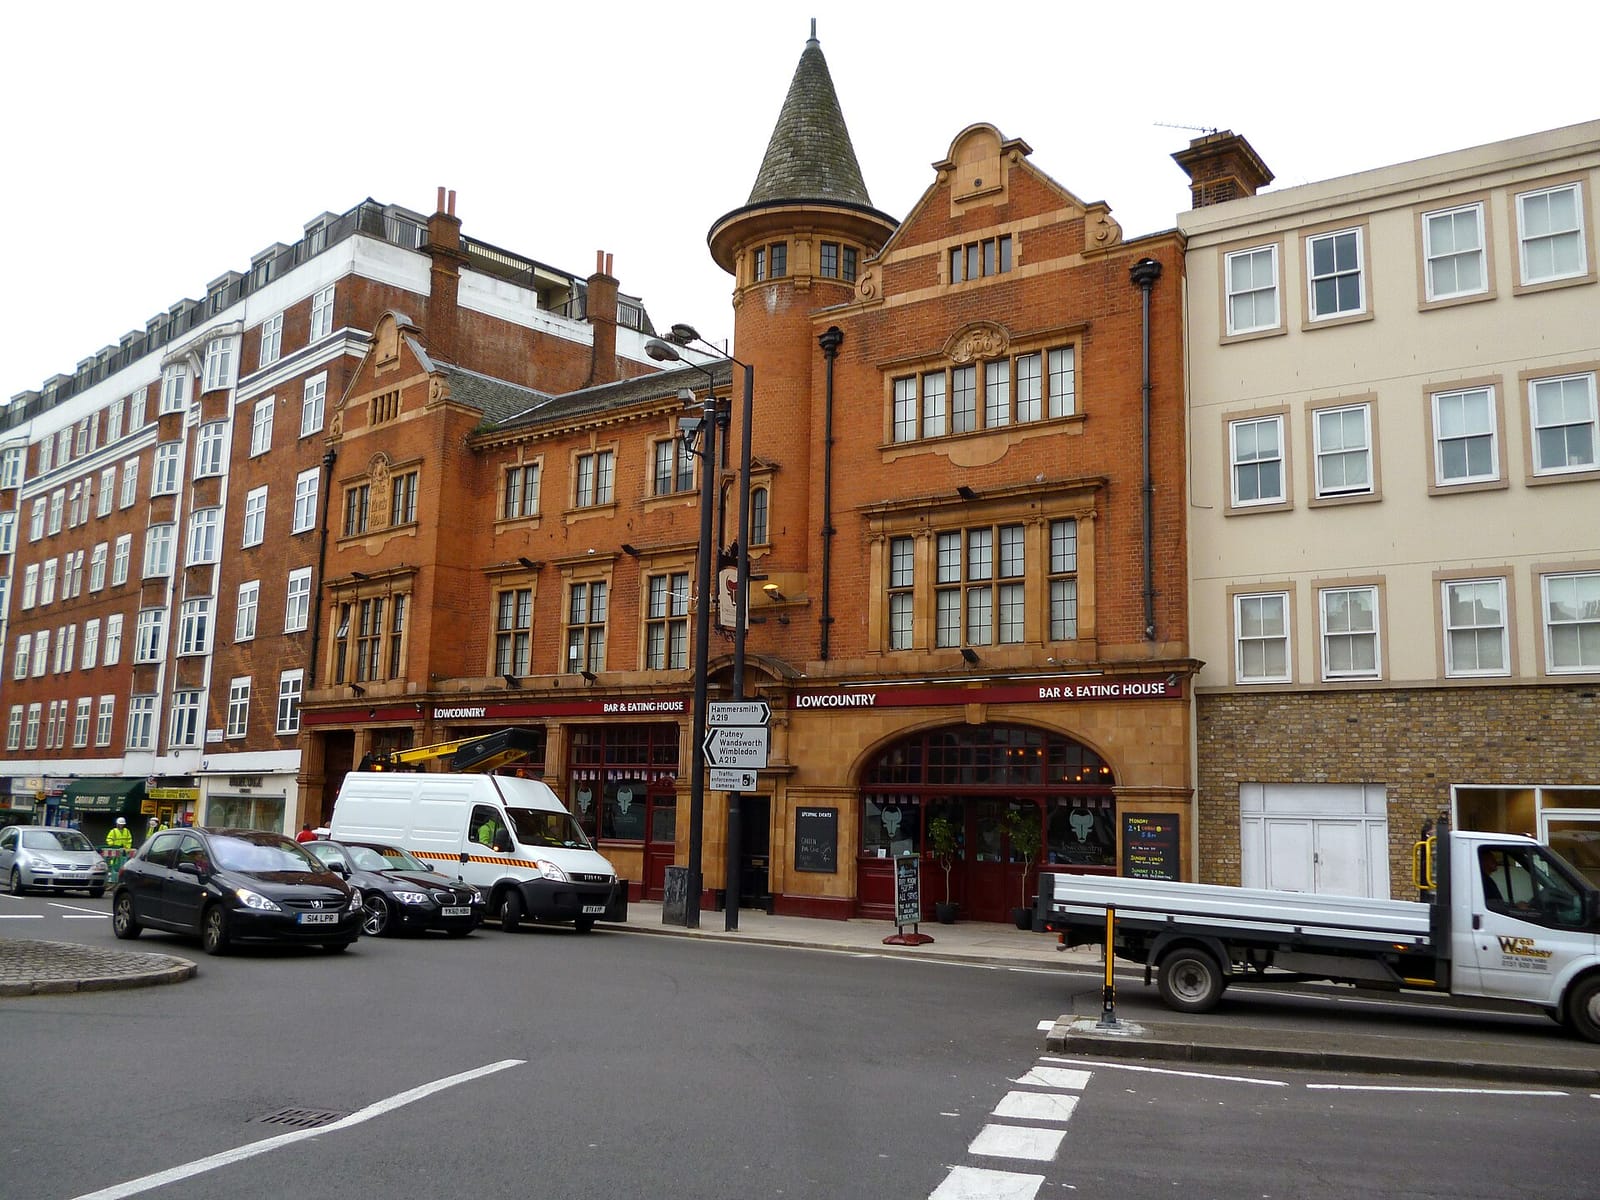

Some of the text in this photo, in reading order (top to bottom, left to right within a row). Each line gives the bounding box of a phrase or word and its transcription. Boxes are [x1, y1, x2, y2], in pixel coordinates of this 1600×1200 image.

[1039, 682, 1165, 698] BAR & EATING HOUSE
[796, 694, 876, 707] LOWCOUNTRY
[603, 701, 684, 712] BAR & EATING HOUSE
[711, 705, 759, 713] Hammersmith
[433, 707, 487, 719] LOWCOUNTRY
[720, 730, 744, 738] Putney
[720, 739, 762, 747] Wandsworth
[719, 747, 757, 755] Wimbledon
[718, 756, 737, 764] A219
[320, 914, 334, 923] LPR
